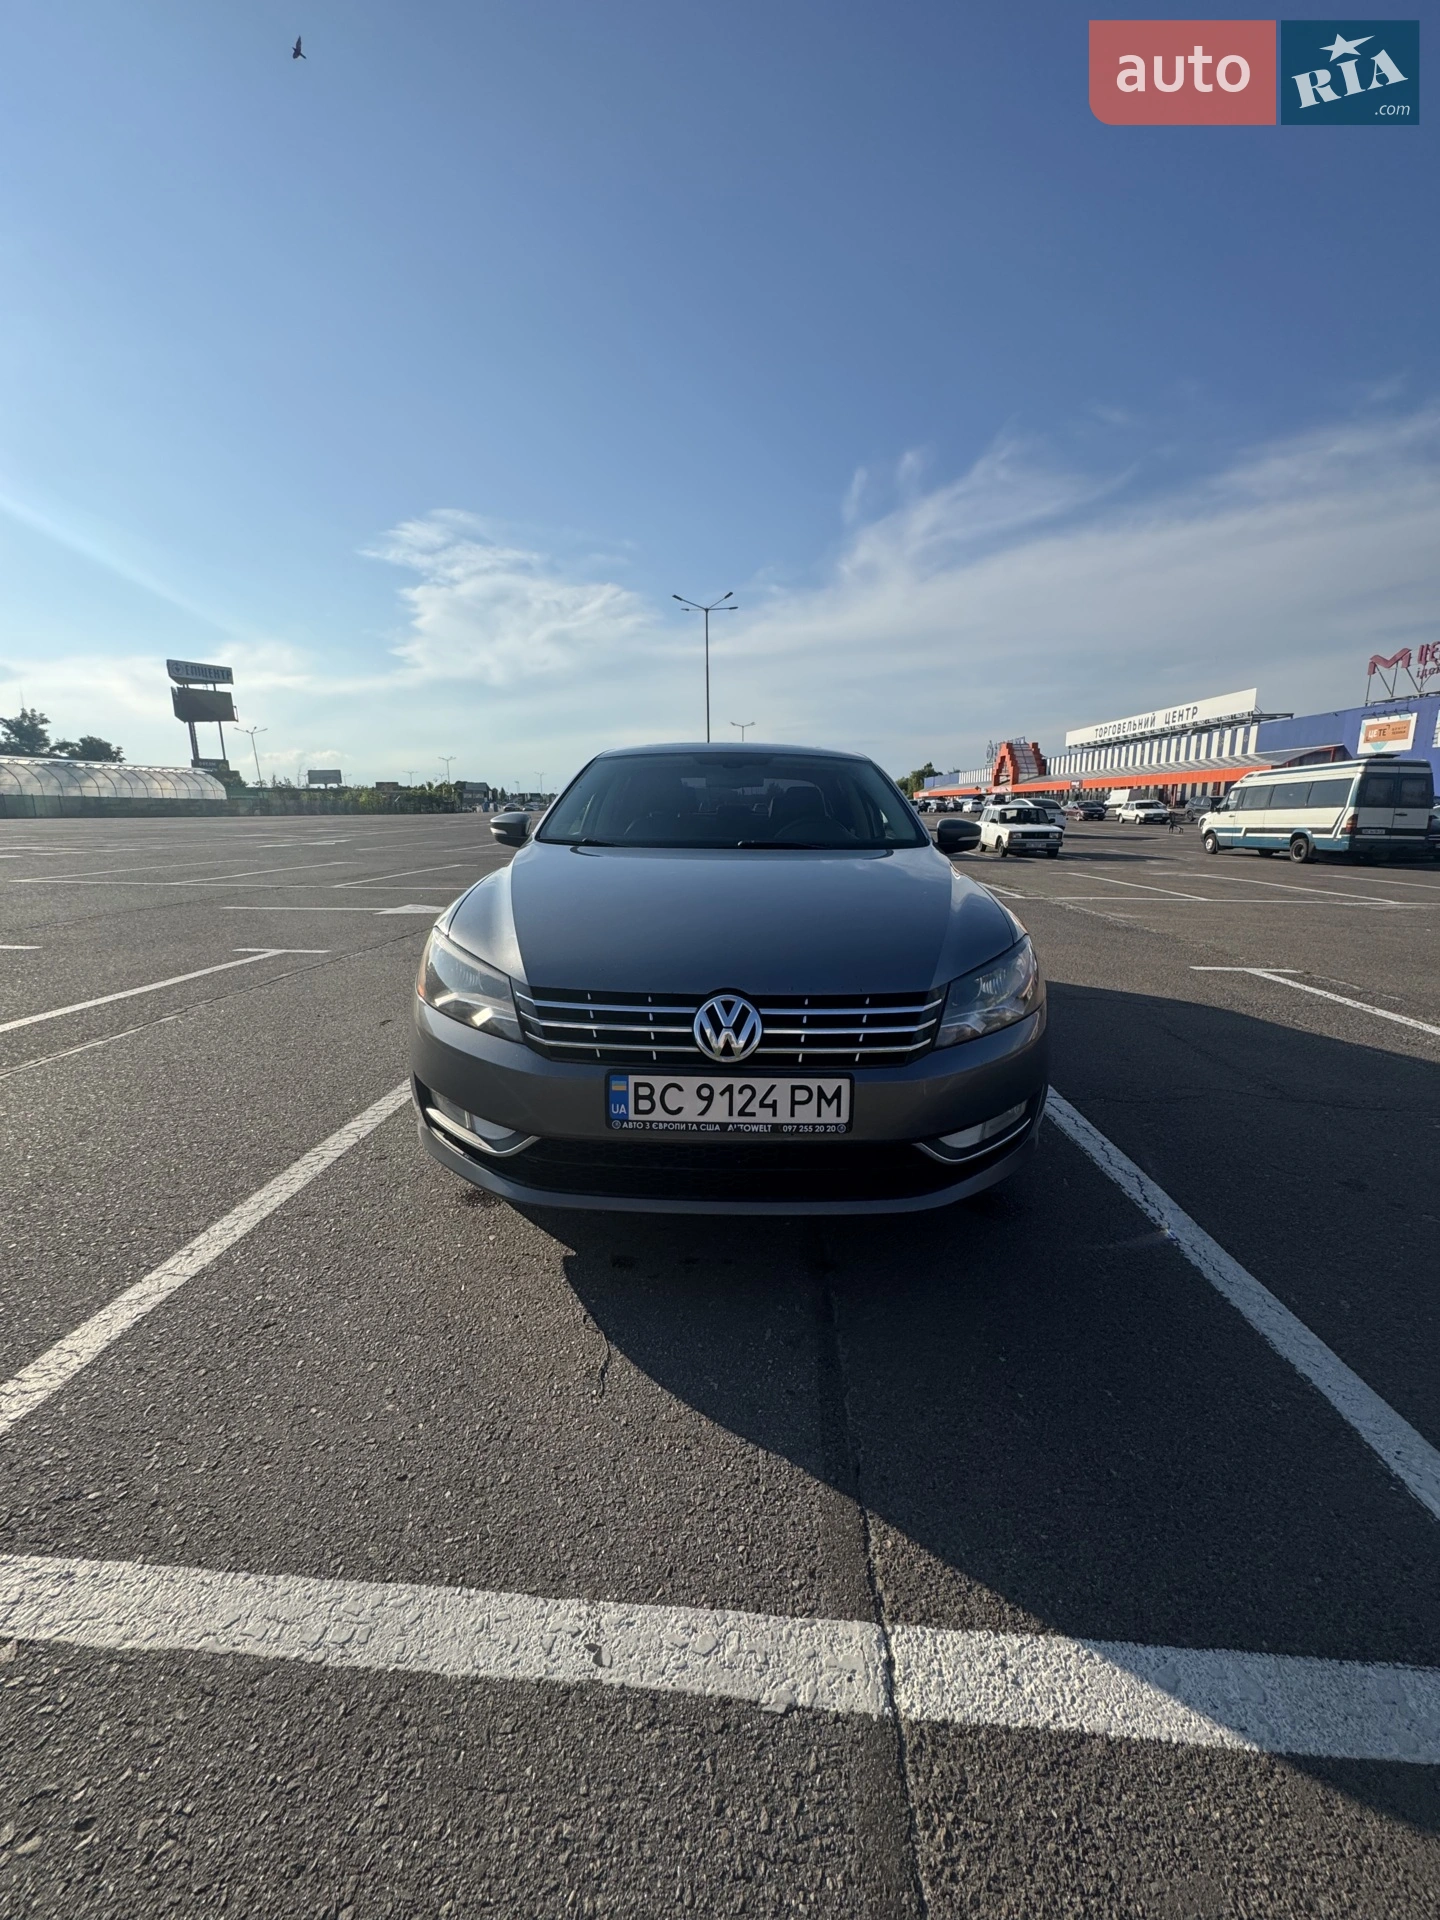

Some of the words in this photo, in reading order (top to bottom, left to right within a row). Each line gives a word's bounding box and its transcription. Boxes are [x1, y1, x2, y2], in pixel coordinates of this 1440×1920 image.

[185, 666, 232, 680] ЕПІЦЕНТР
[1095, 713, 1156, 738] ТОРГОВЕЛЬНИЙ
[1164, 705, 1198, 725] ЦЕНТР
[633, 1081, 685, 1115] BC
[695, 1082, 778, 1118] 9124
[790, 1084, 842, 1118] PM
[611, 1103, 627, 1115] UA
[622, 1121, 643, 1129] АВТО
[652, 1122, 686, 1130] ЄВРОПИ
[699, 1123, 720, 1131] США
[783, 1124, 797, 1132] 097
[799, 1124, 813, 1132] 255
